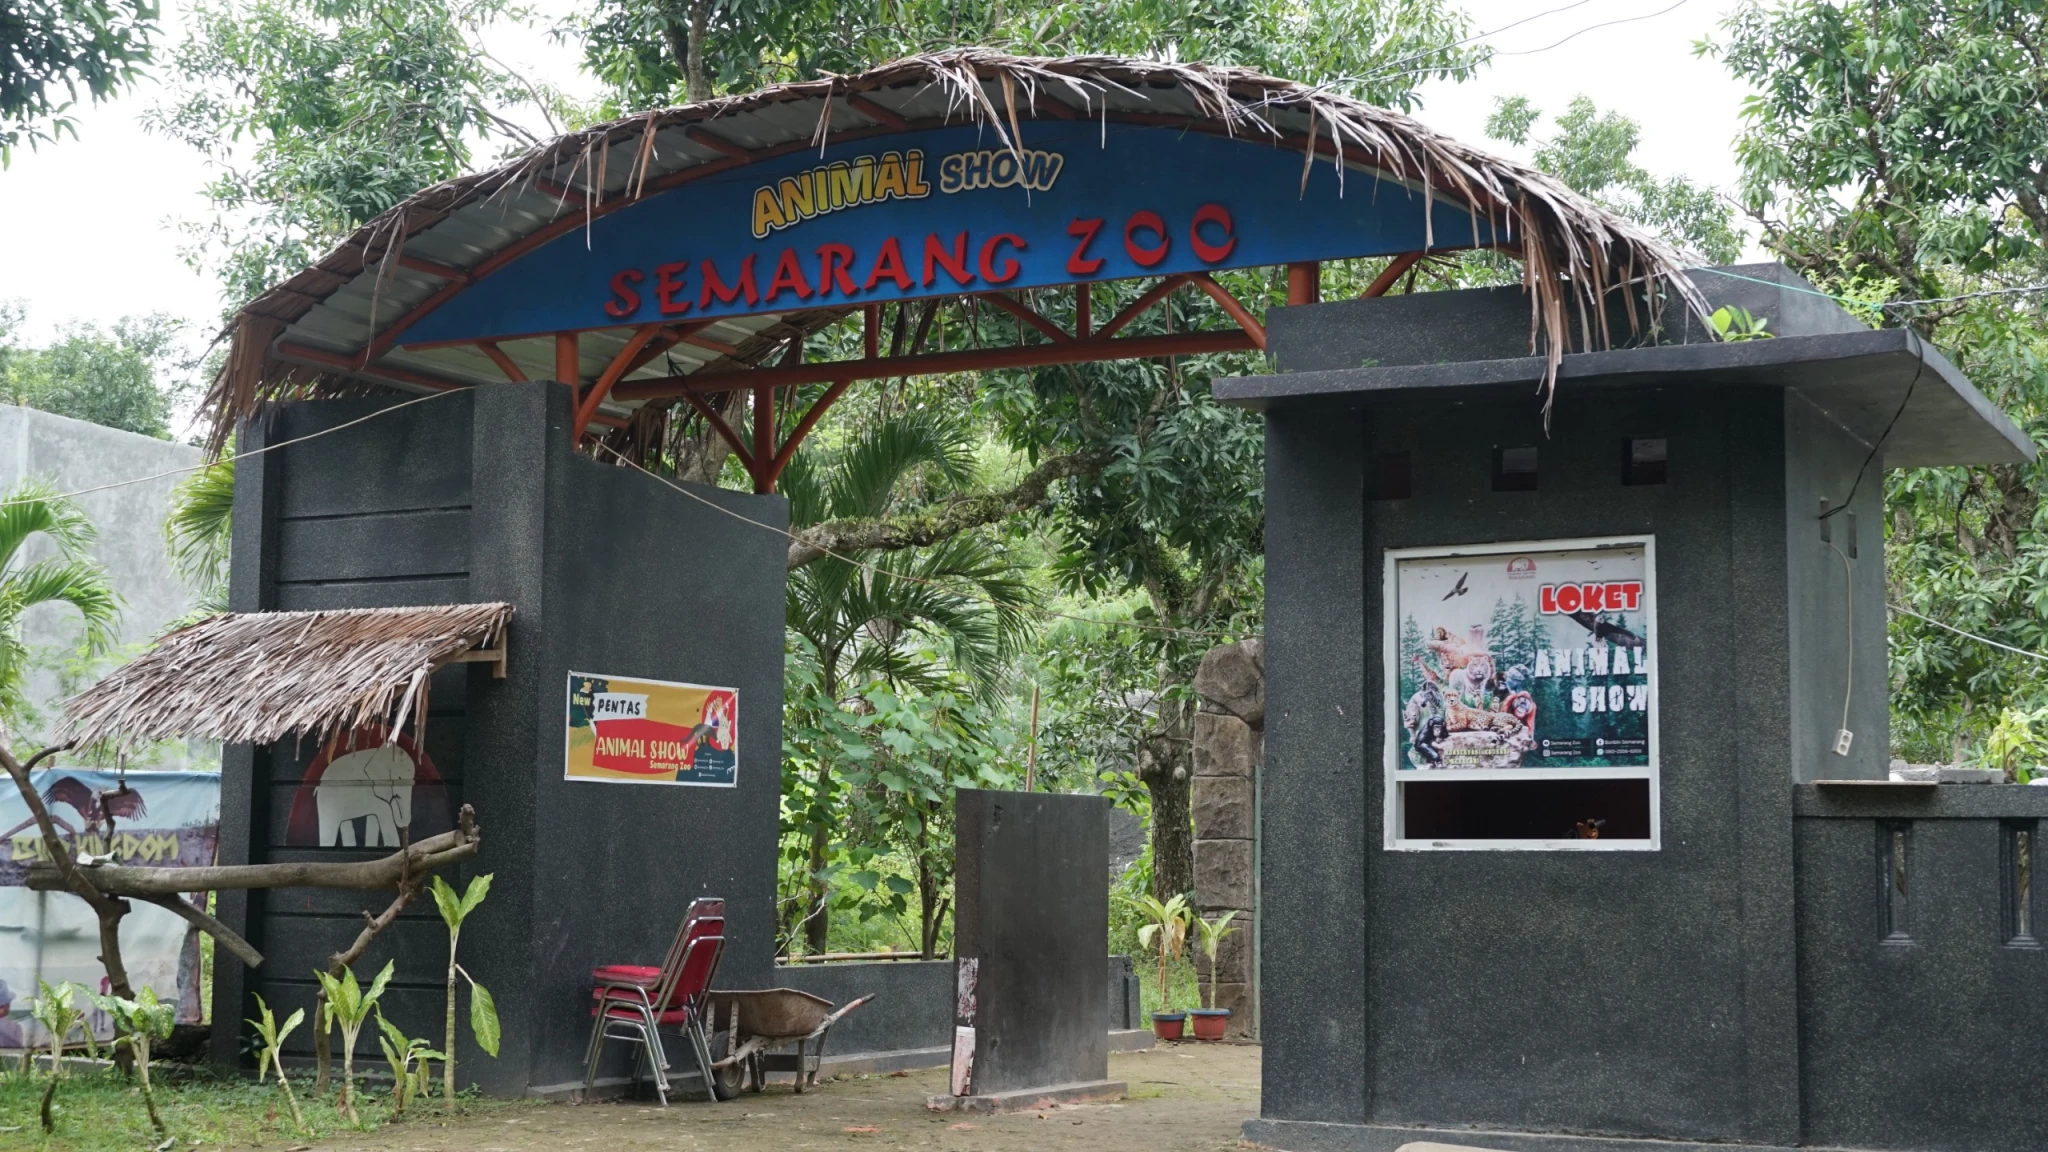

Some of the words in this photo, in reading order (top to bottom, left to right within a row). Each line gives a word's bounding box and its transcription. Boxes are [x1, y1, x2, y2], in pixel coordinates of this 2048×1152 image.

[751, 149, 932, 238] ANIMAL
[940, 149, 1064, 193] SHOW
[602, 230, 1027, 319] SEMARANG
[1066, 203, 1237, 276] ZOO
[1539, 580, 1644, 615] LOKET
[1535, 646, 1648, 677] ANIMAL
[572, 693, 592, 707] New
[597, 698, 641, 716] PENTAS
[1571, 685, 1648, 713] SHOW
[595, 736, 647, 759] ANIMAL
[649, 740, 690, 761] SHOW
[649, 760, 679, 771] Semarang
[679, 761, 692, 771] Zoo
